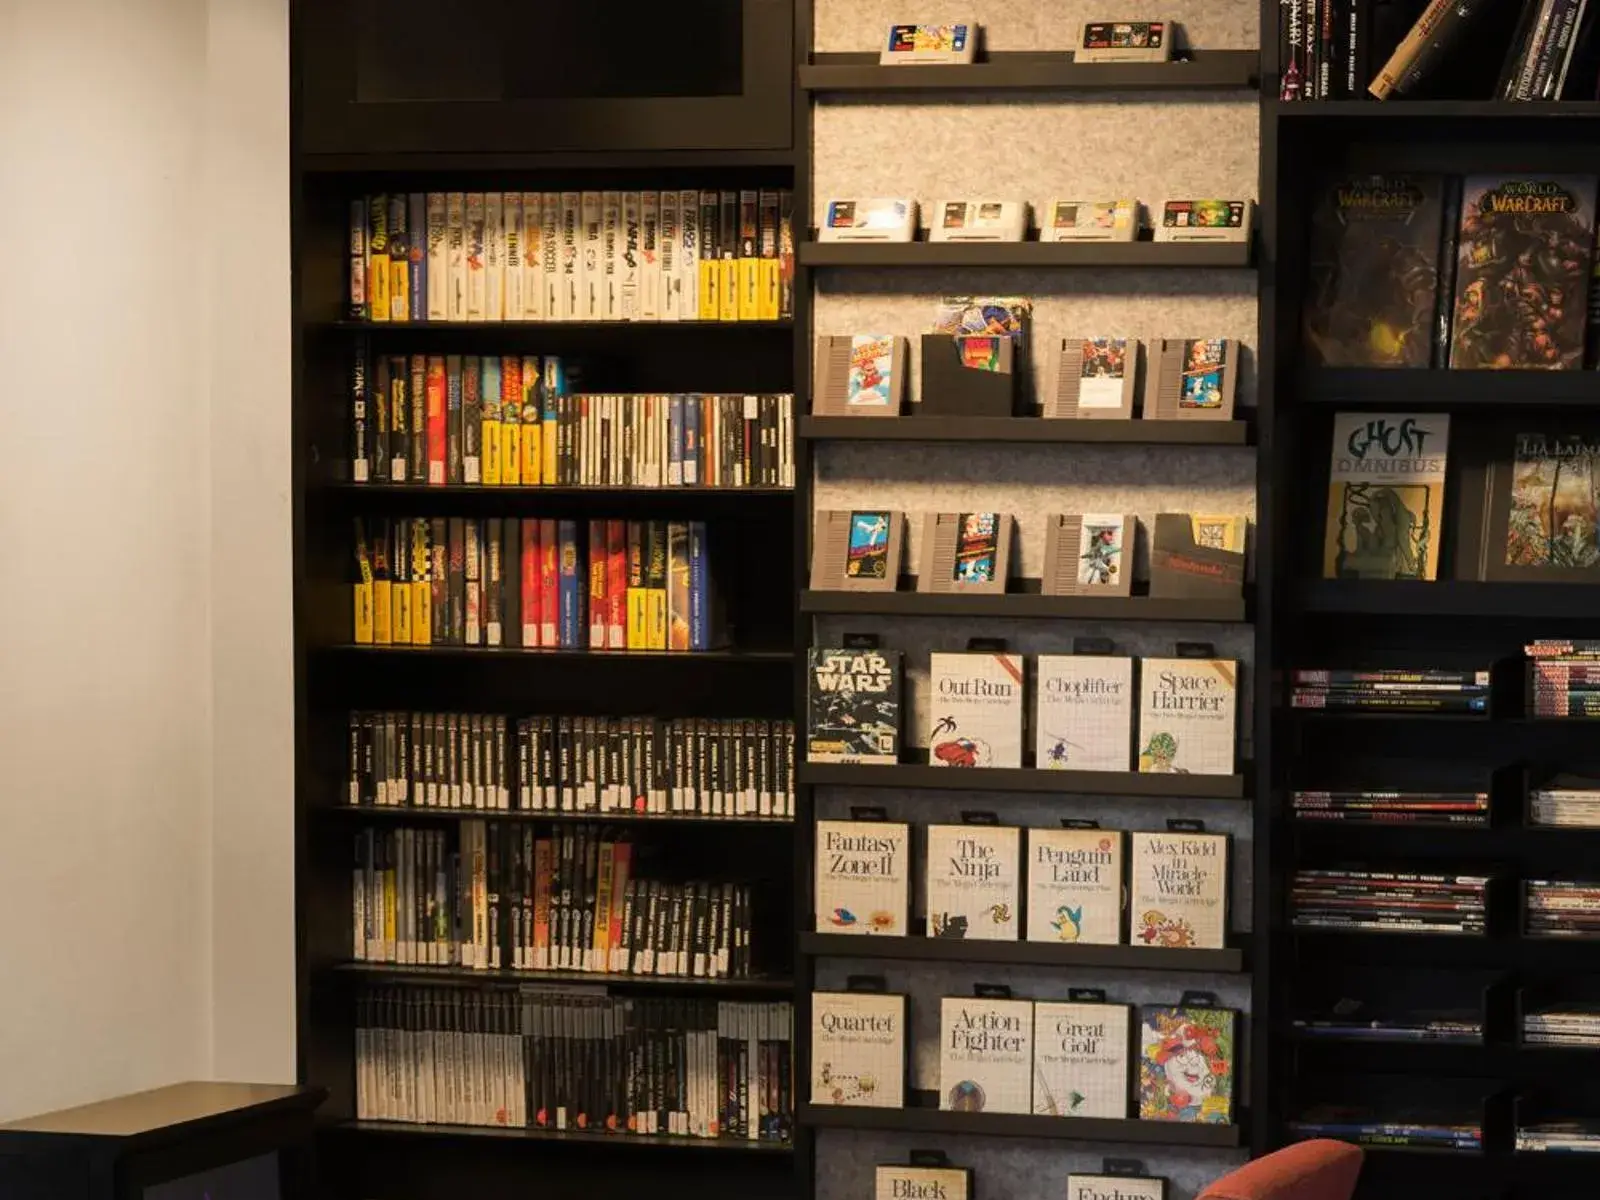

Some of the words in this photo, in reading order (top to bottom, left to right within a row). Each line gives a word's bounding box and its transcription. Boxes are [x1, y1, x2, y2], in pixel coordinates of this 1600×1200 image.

[1505, 183, 1558, 195] WORLD
[1491, 197, 1567, 213] WARCRAFT
[1348, 418, 1434, 459] GHOST
[1335, 459, 1440, 473] OMNIBUS
[816, 655, 891, 674] STAR
[817, 673, 891, 692] WARS
[1046, 677, 1123, 696] Choplifter
[1160, 669, 1217, 694] Space
[1152, 690, 1225, 711] Harrier
[826, 831, 898, 853] Fantasy
[957, 839, 994, 858] The
[1144, 838, 1178, 854] Alex
[1181, 840, 1217, 856] Kidd
[830, 853, 877, 874] Zone
[1038, 845, 1112, 867] Penguin
[1172, 856, 1187, 869] in
[950, 857, 1000, 881] Ninja
[1052, 864, 1099, 883] Land
[1152, 864, 1207, 882] Miracle
[1157, 879, 1203, 896] World
[821, 1011, 894, 1033] Quartet
[955, 1008, 1020, 1031] Action
[1056, 1021, 1104, 1037] Great
[951, 1029, 1025, 1053] Fighter
[1061, 1037, 1099, 1054] Golf
[891, 1179, 946, 1200] Black
